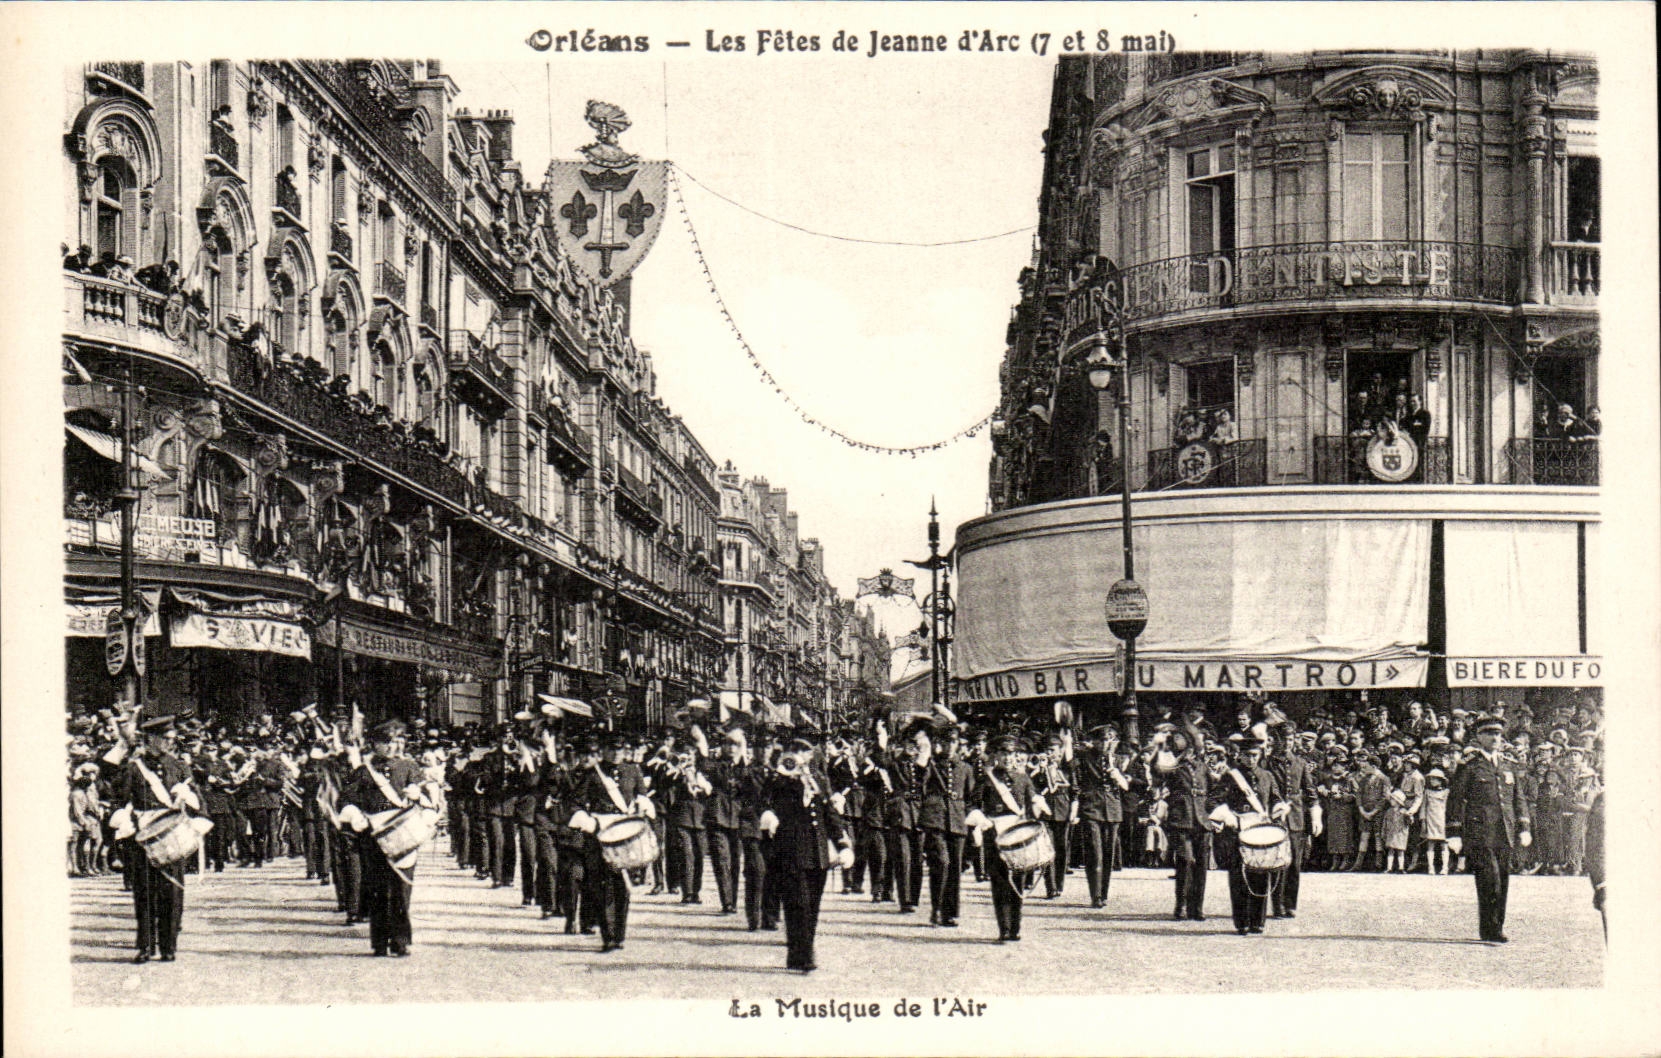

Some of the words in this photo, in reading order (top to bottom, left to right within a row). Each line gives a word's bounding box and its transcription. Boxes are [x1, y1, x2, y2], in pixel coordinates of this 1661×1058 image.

[1207, 250, 1450, 299] DENTISTE
[1034, 669, 1090, 695] BAR
[1455, 662, 1527, 679] BIERE
[1535, 662, 1564, 679] DU
